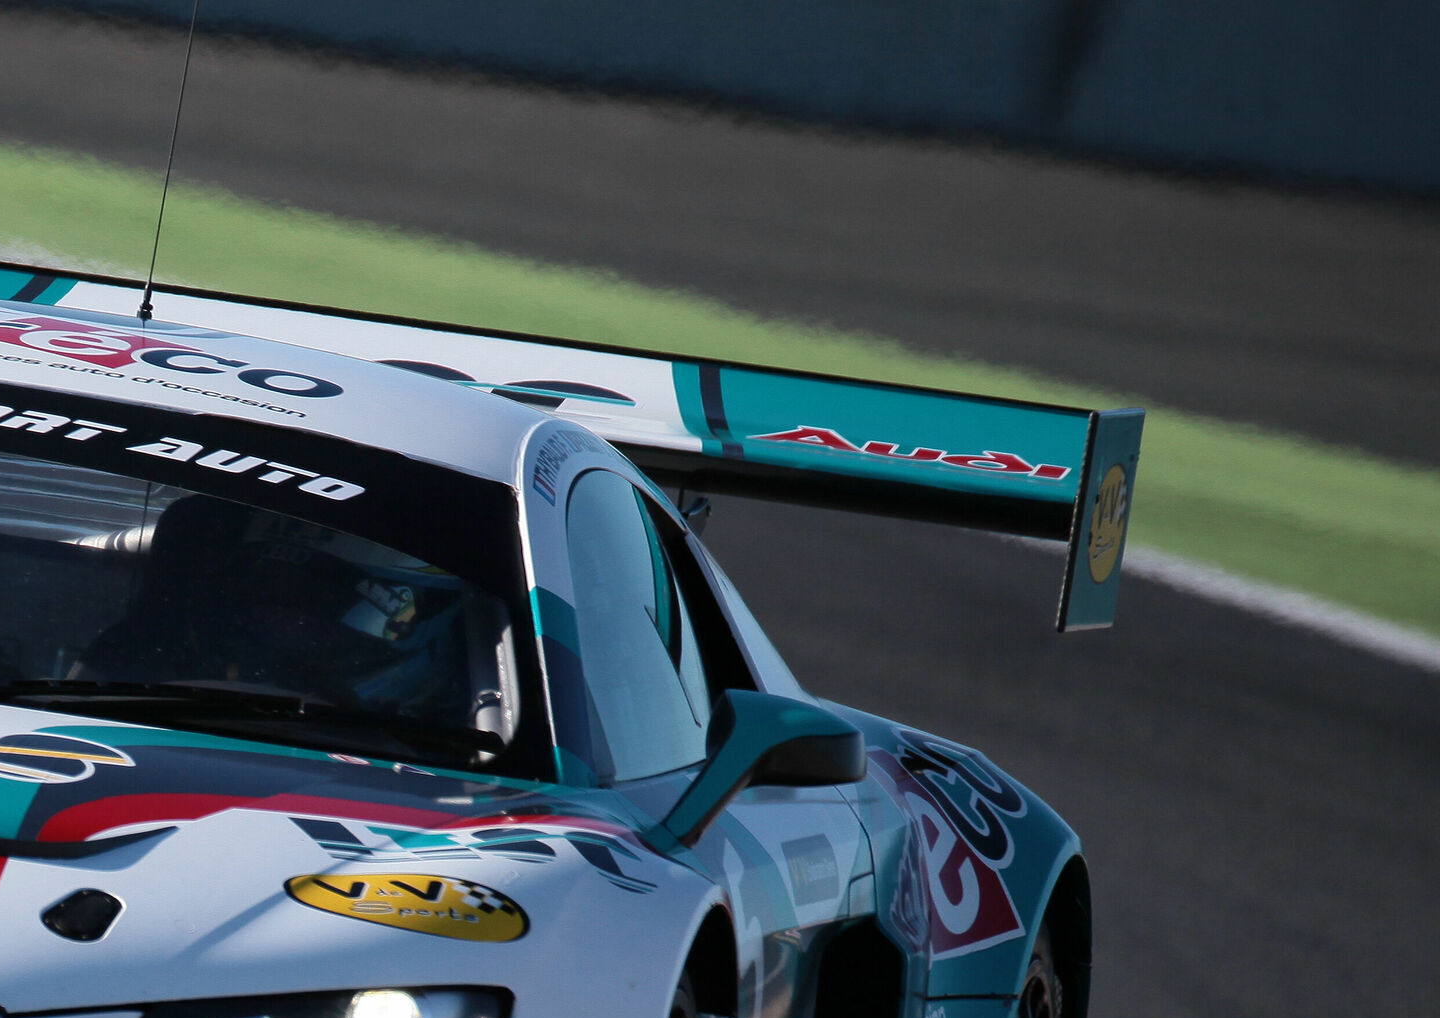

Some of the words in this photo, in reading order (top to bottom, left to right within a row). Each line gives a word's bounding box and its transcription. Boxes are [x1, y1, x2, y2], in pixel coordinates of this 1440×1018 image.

[48, 362, 126, 379] auto
[131, 376, 308, 419] d'occasion
[125, 436, 366, 502] AUTO
[746, 425, 1072, 480] Audi
[312, 878, 369, 900] V
[388, 880, 447, 904] V
[350, 900, 480, 924] Sports
